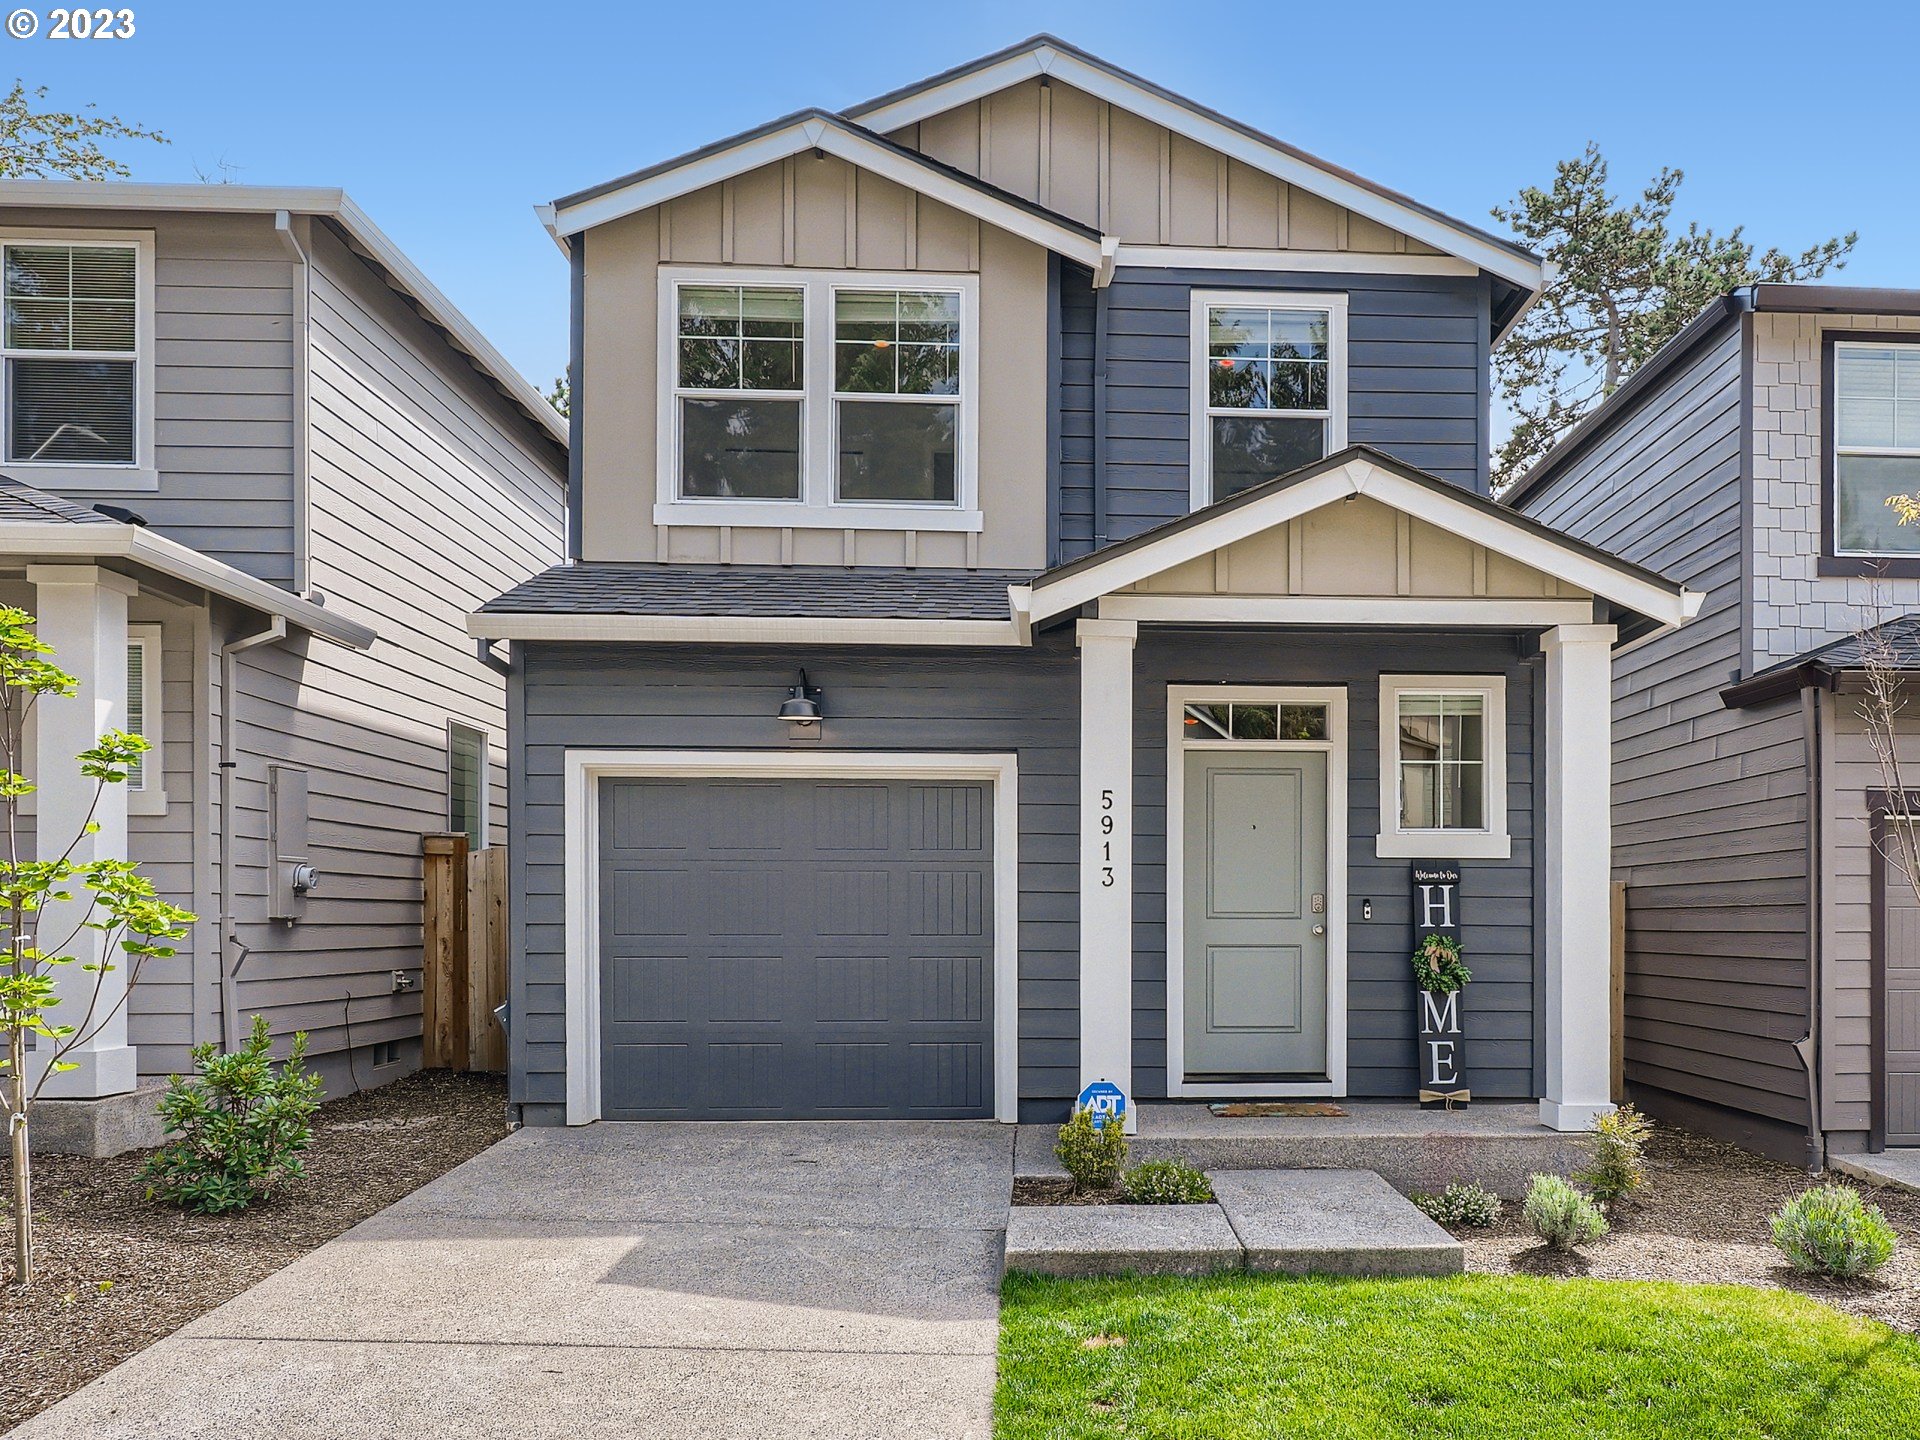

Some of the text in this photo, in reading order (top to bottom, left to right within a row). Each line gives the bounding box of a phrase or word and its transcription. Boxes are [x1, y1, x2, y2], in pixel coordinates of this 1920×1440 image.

[1101, 789, 1114, 887] 5913
[1418, 885, 1462, 1085] HME
[1085, 1095, 1121, 1114] ADT
